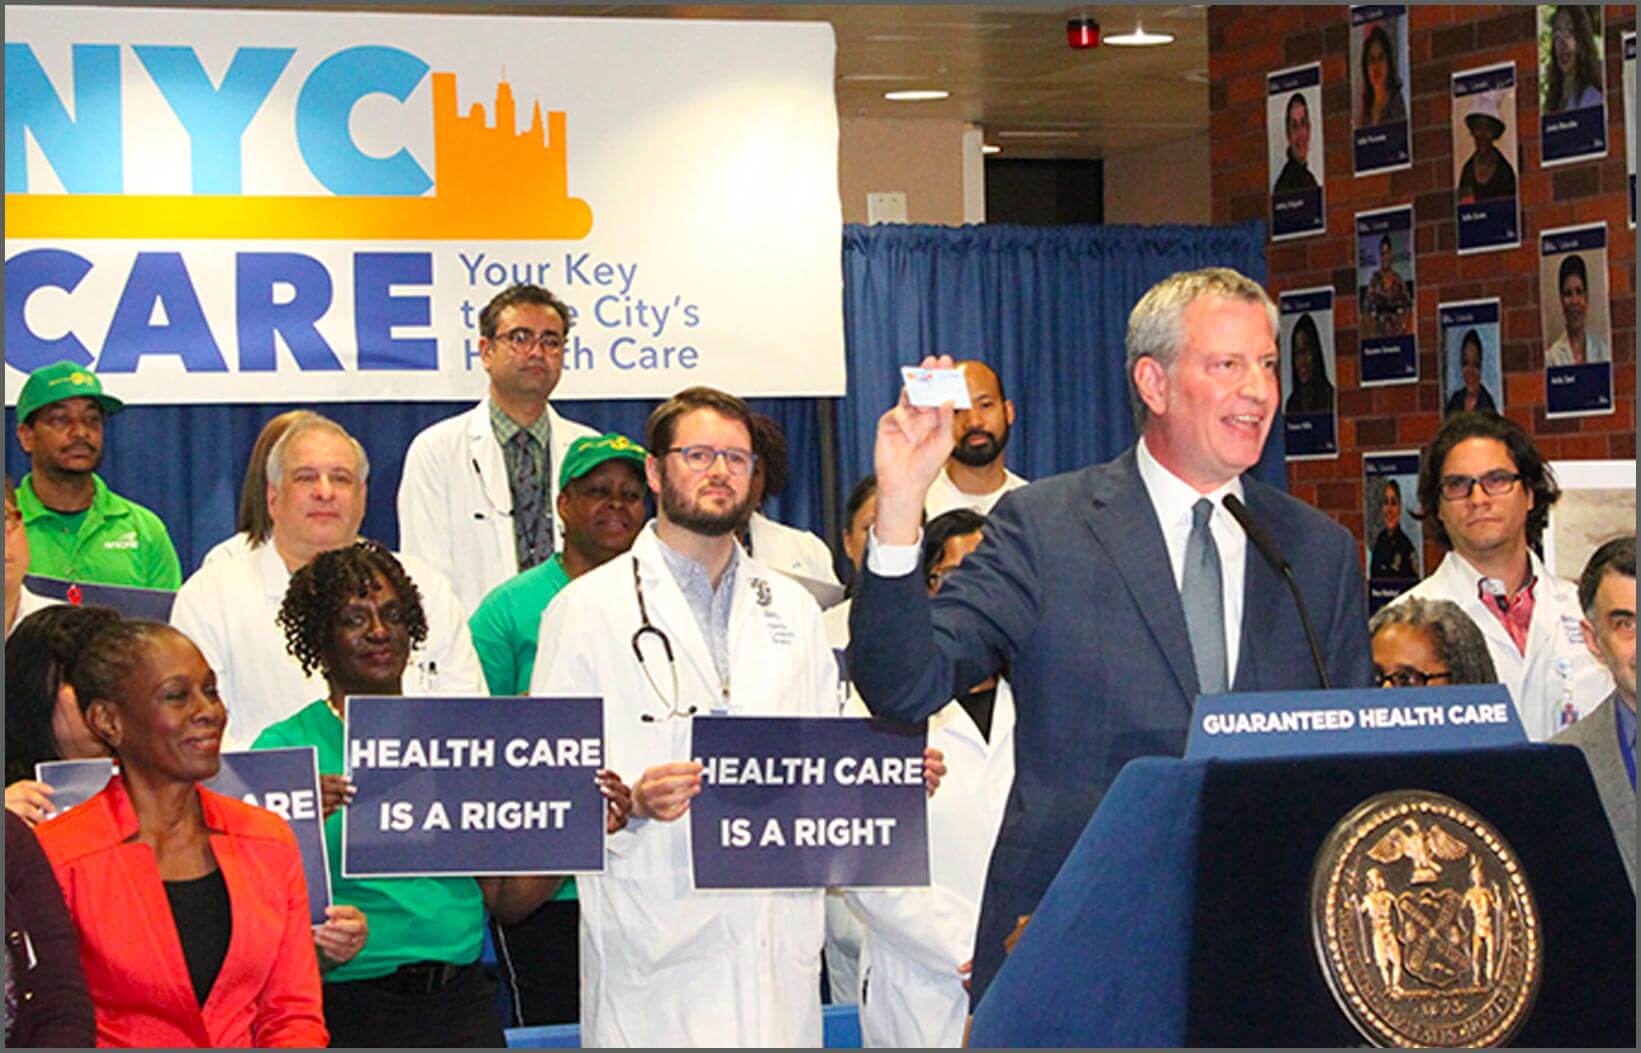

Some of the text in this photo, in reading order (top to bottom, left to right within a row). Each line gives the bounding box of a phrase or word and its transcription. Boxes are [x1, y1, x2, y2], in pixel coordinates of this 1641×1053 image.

[5, 42, 434, 197] NYC
[459, 253, 638, 295] Your Key
[5, 249, 438, 374] CARE
[593, 296, 700, 337] City's
[609, 337, 699, 371] Care
[1202, 703, 1508, 735] GUARANTEED HEALTH CARE
[351, 738, 602, 769] HEALTH CARE
[833, 756, 924, 785] CARE
[380, 801, 572, 831] IS A RIGHT
[721, 817, 897, 848] IS A RIGHT
